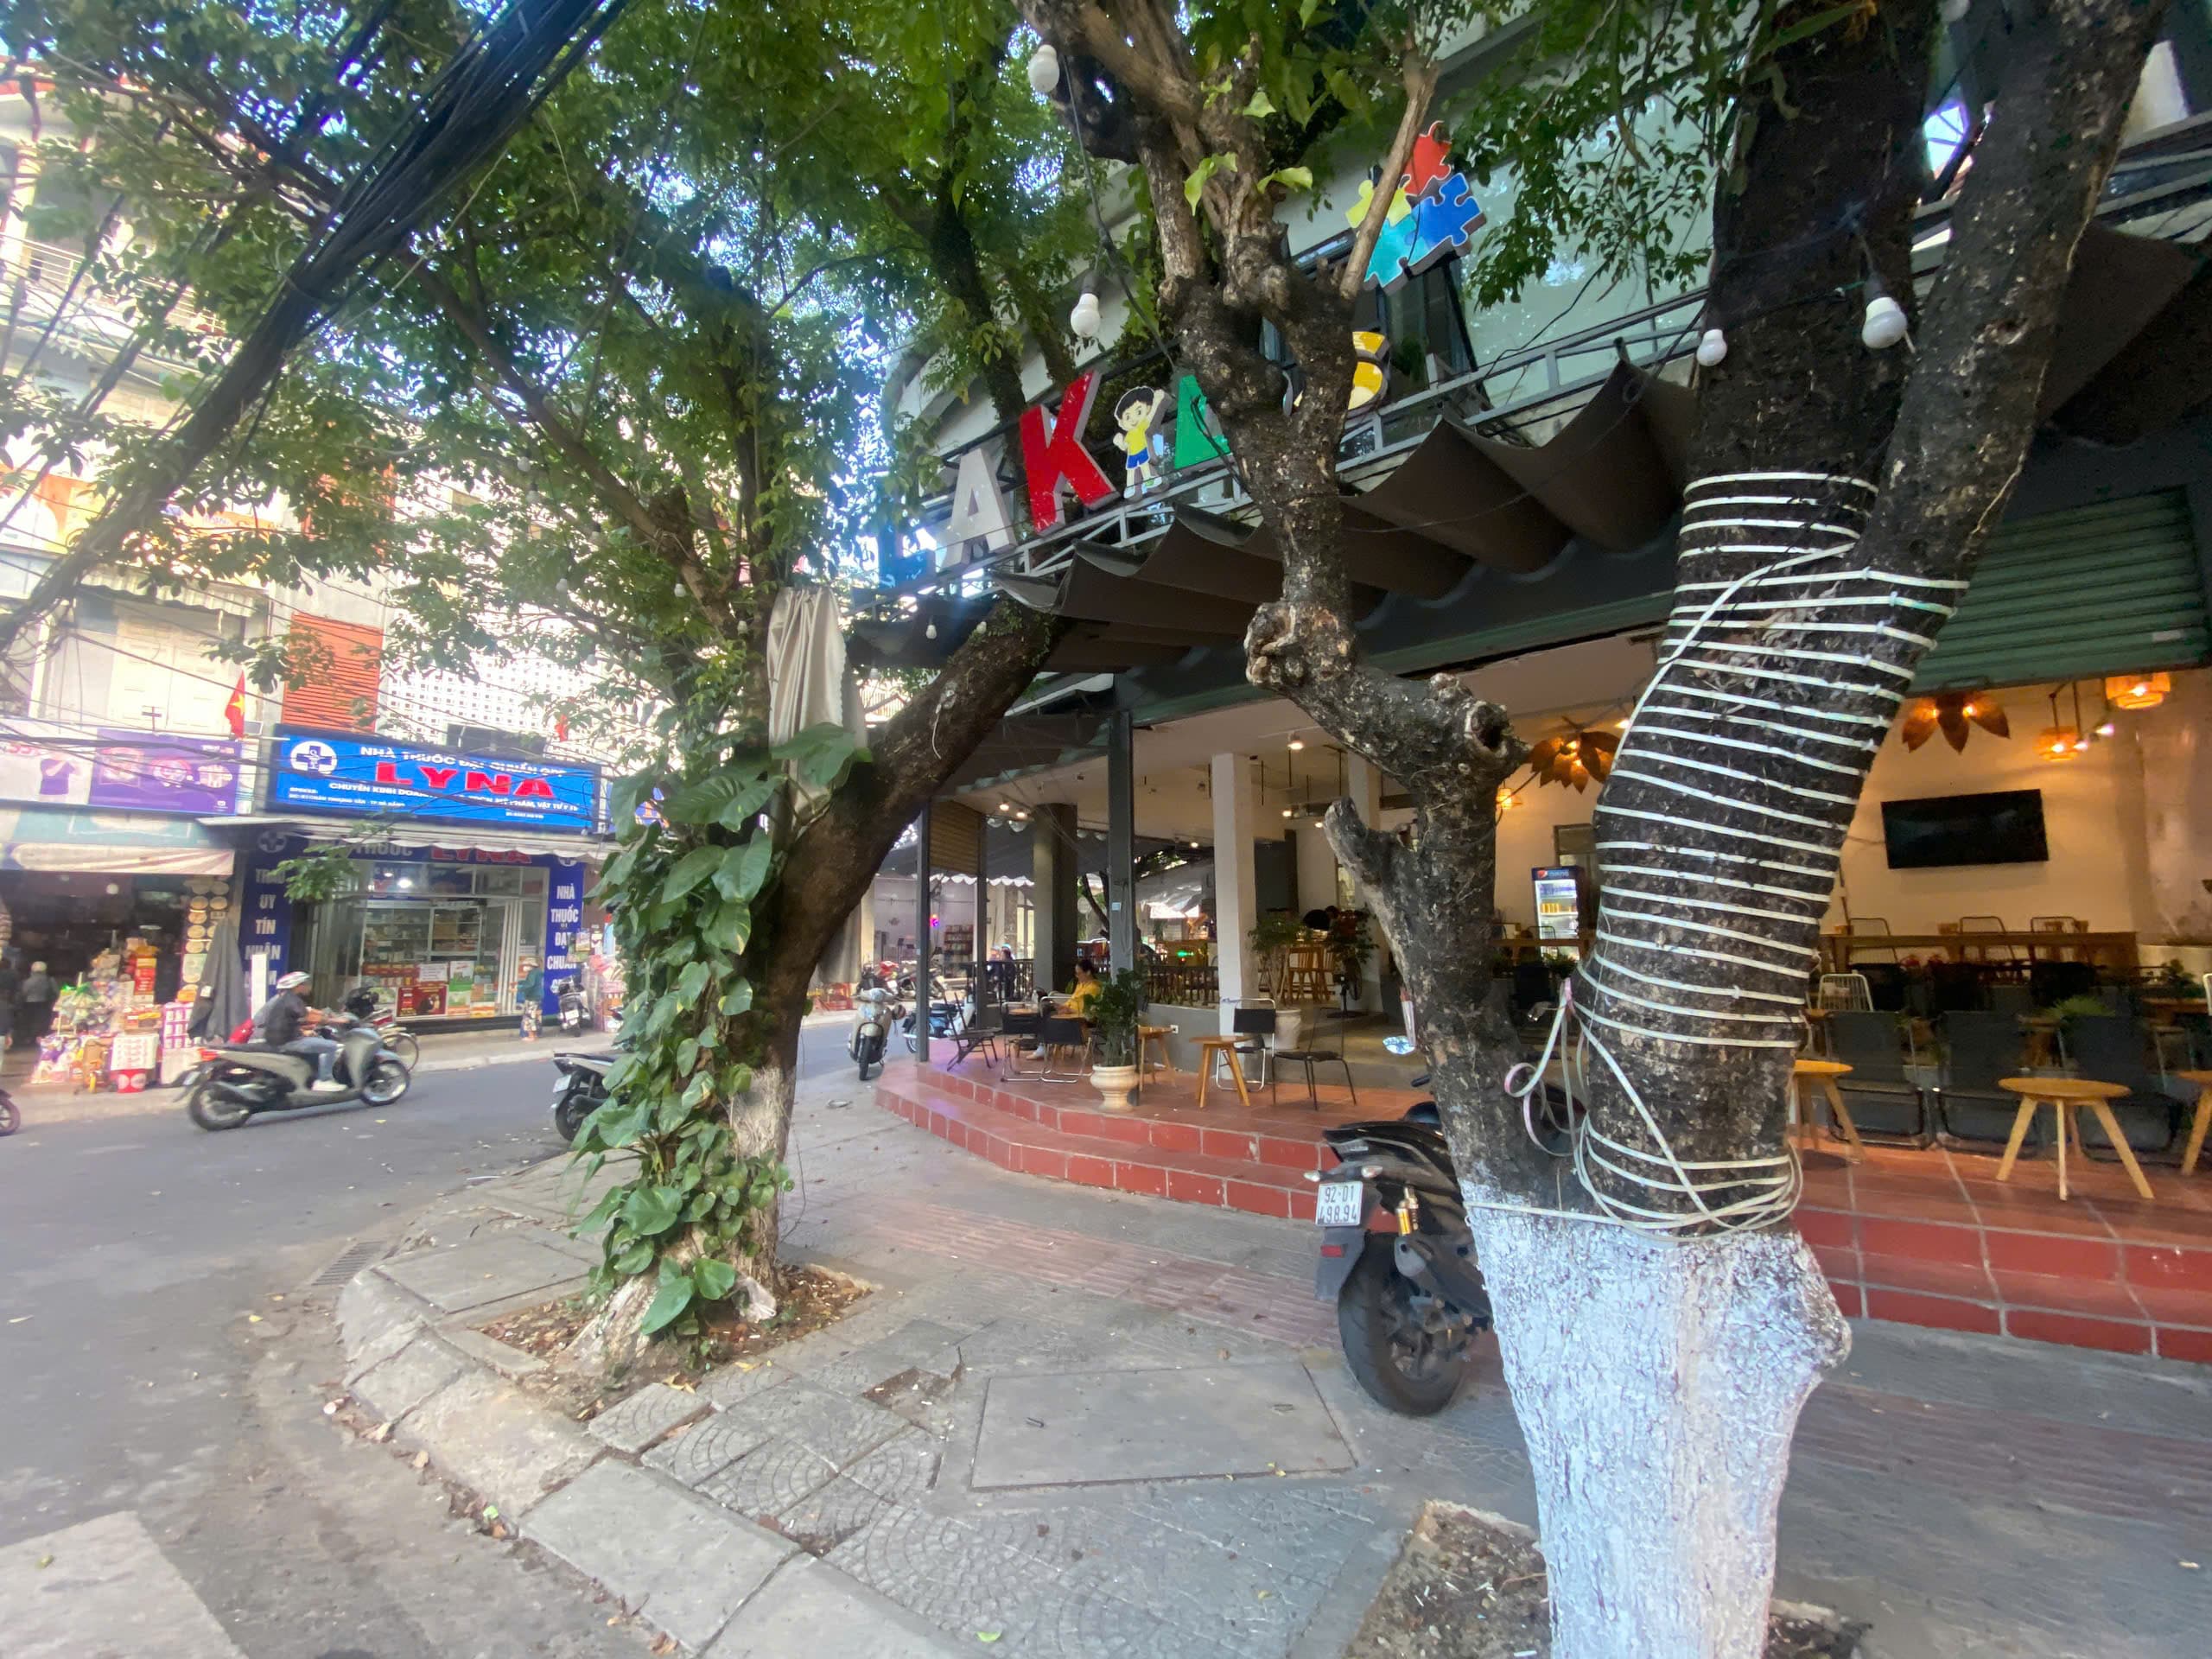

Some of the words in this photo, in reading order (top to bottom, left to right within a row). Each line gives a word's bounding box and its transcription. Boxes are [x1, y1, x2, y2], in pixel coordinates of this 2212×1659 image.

[329, 782, 371, 792] CHUYÊN
[375, 761, 555, 799] LYNA
[556, 883, 575, 900] NHÀ
[550, 904, 579, 923] THUỐC
[256, 917, 276, 935] TÍN
